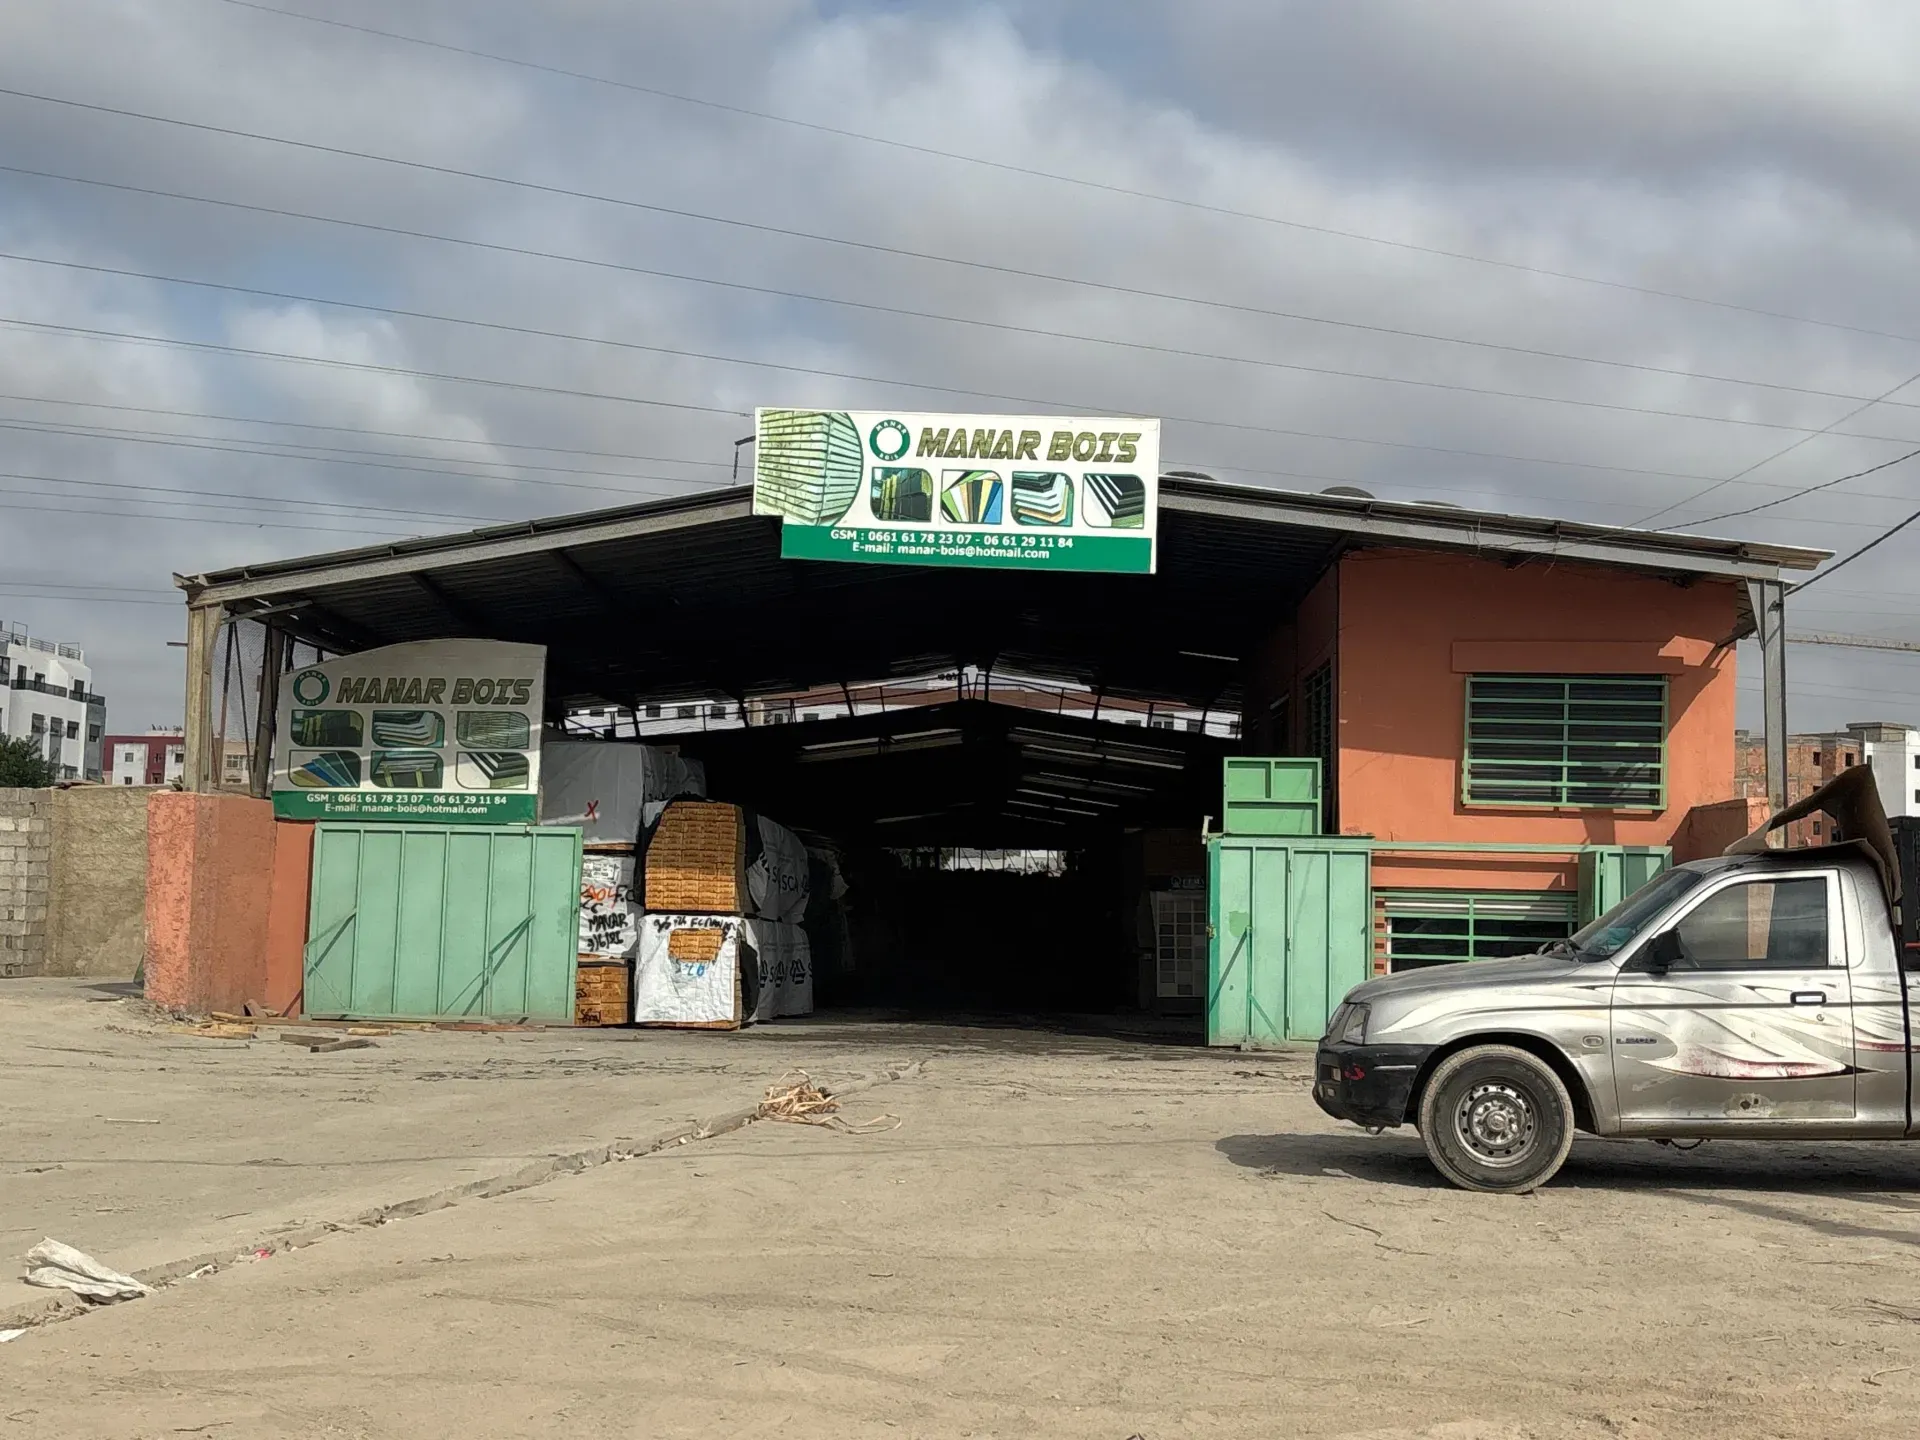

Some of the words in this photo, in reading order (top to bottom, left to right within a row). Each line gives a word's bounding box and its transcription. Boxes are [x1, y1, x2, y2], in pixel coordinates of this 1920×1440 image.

[916, 427, 1041, 460] MANAR
[1047, 431, 1142, 463] BOIS
[830, 530, 857, 541] GSM
[868, 531, 897, 542] 0661
[902, 532, 916, 543] 61
[920, 533, 935, 543] 78
[938, 533, 953, 544] 23
[956, 534, 971, 545] 07
[984, 535, 999, 546] 06
[1002, 536, 1017, 546] 61
[1021, 536, 1036, 547] 29
[1040, 537, 1055, 548] 11
[1058, 537, 1073, 548] 84
[852, 542, 894, 553] E-mail:
[897, 543, 1050, 559] manar-bois@hotmail.com
[336, 677, 447, 704] MANAR
[450, 678, 534, 705] BOIS
[307, 794, 329, 803] GSM
[338, 794, 362, 803] 0661
[366, 794, 378, 803] 61
[380, 794, 393, 803] 78
[396, 794, 408, 803] 23
[410, 795, 423, 803] 07
[433, 795, 446, 804] 06
[448, 795, 460, 804] 61
[464, 795, 476, 804] 29
[479, 796, 491, 804] 11
[494, 796, 507, 805] 84
[325, 803, 359, 812] E-mail:
[362, 804, 488, 814] manar-bois@hotmail.com
